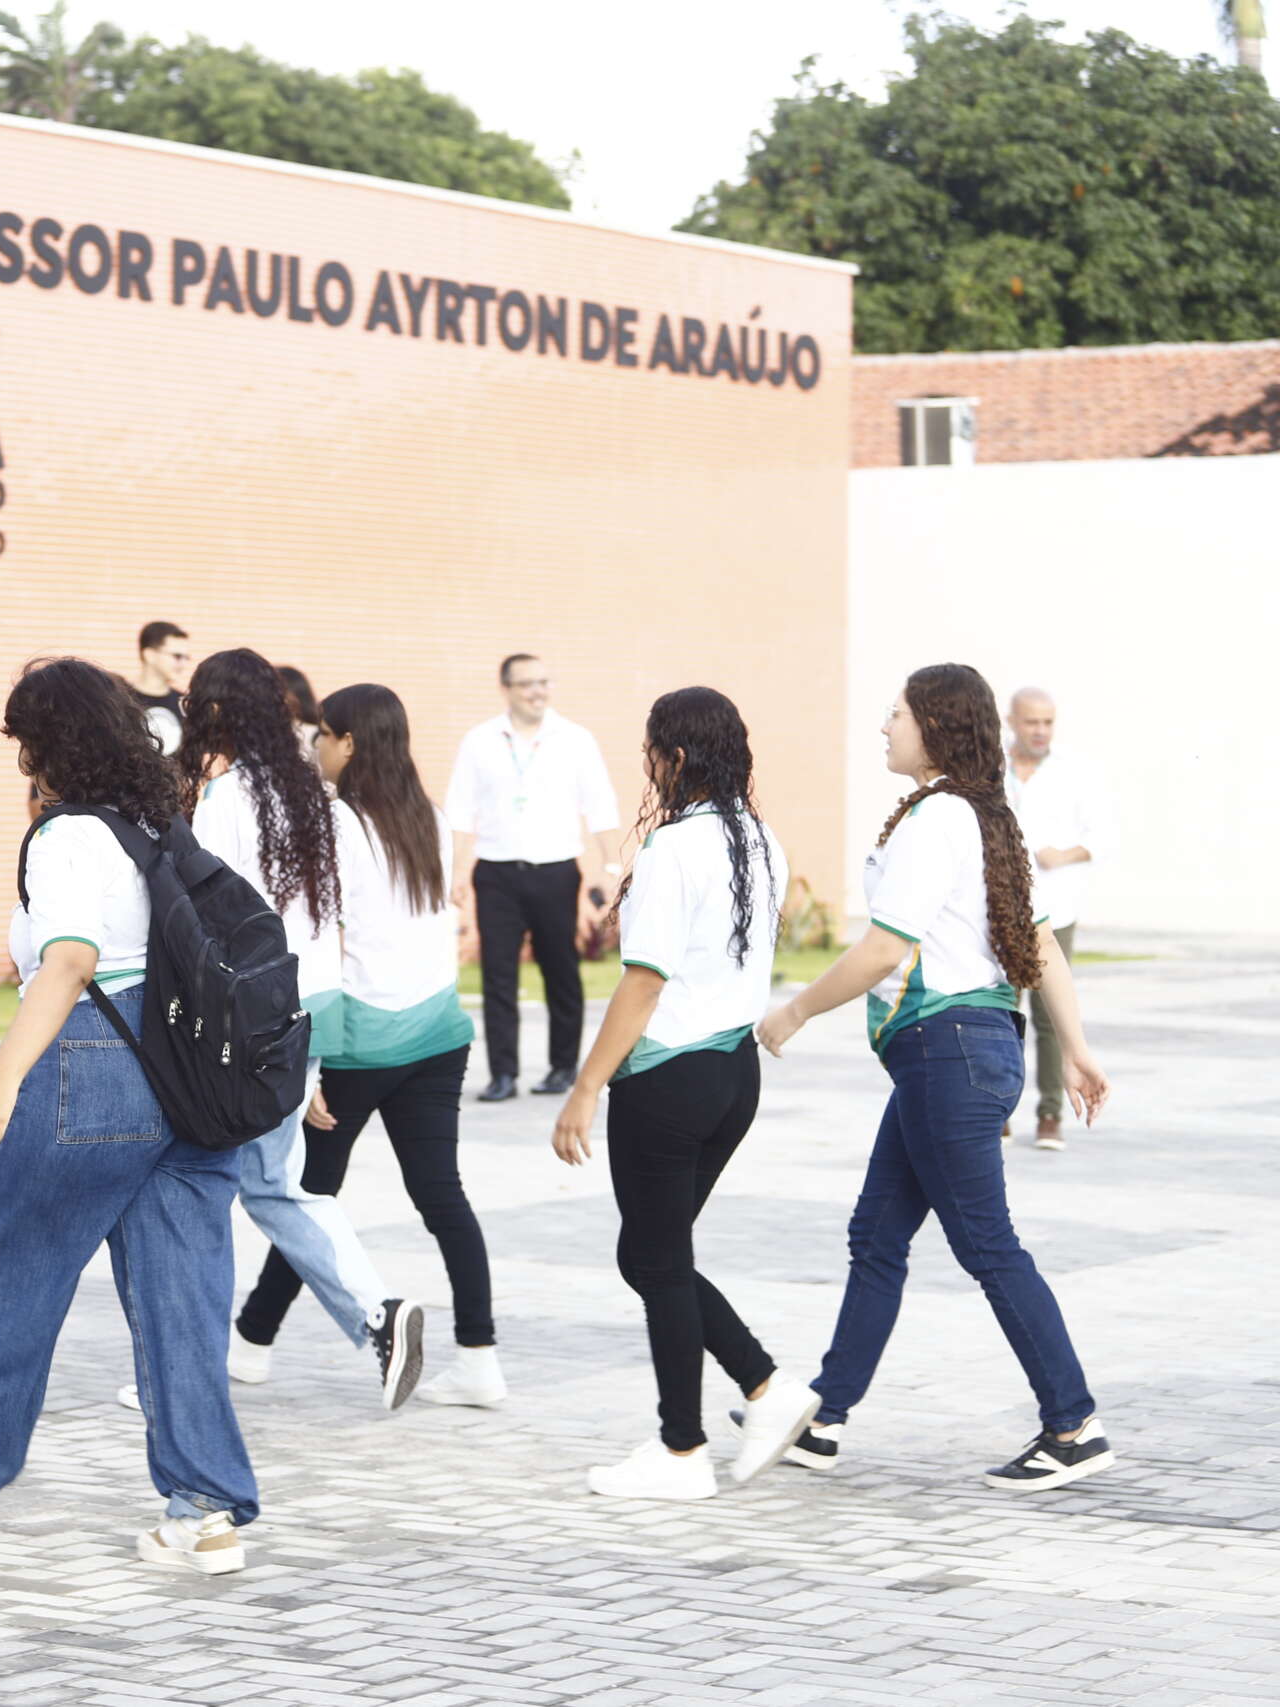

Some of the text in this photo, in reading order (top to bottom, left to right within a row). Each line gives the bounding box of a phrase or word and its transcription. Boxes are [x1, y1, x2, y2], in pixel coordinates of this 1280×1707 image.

[171, 238, 354, 326] PAULO
[364, 270, 567, 358] AYRTON
[580, 301, 639, 368] DE
[647, 306, 821, 391] ARAÚJO
